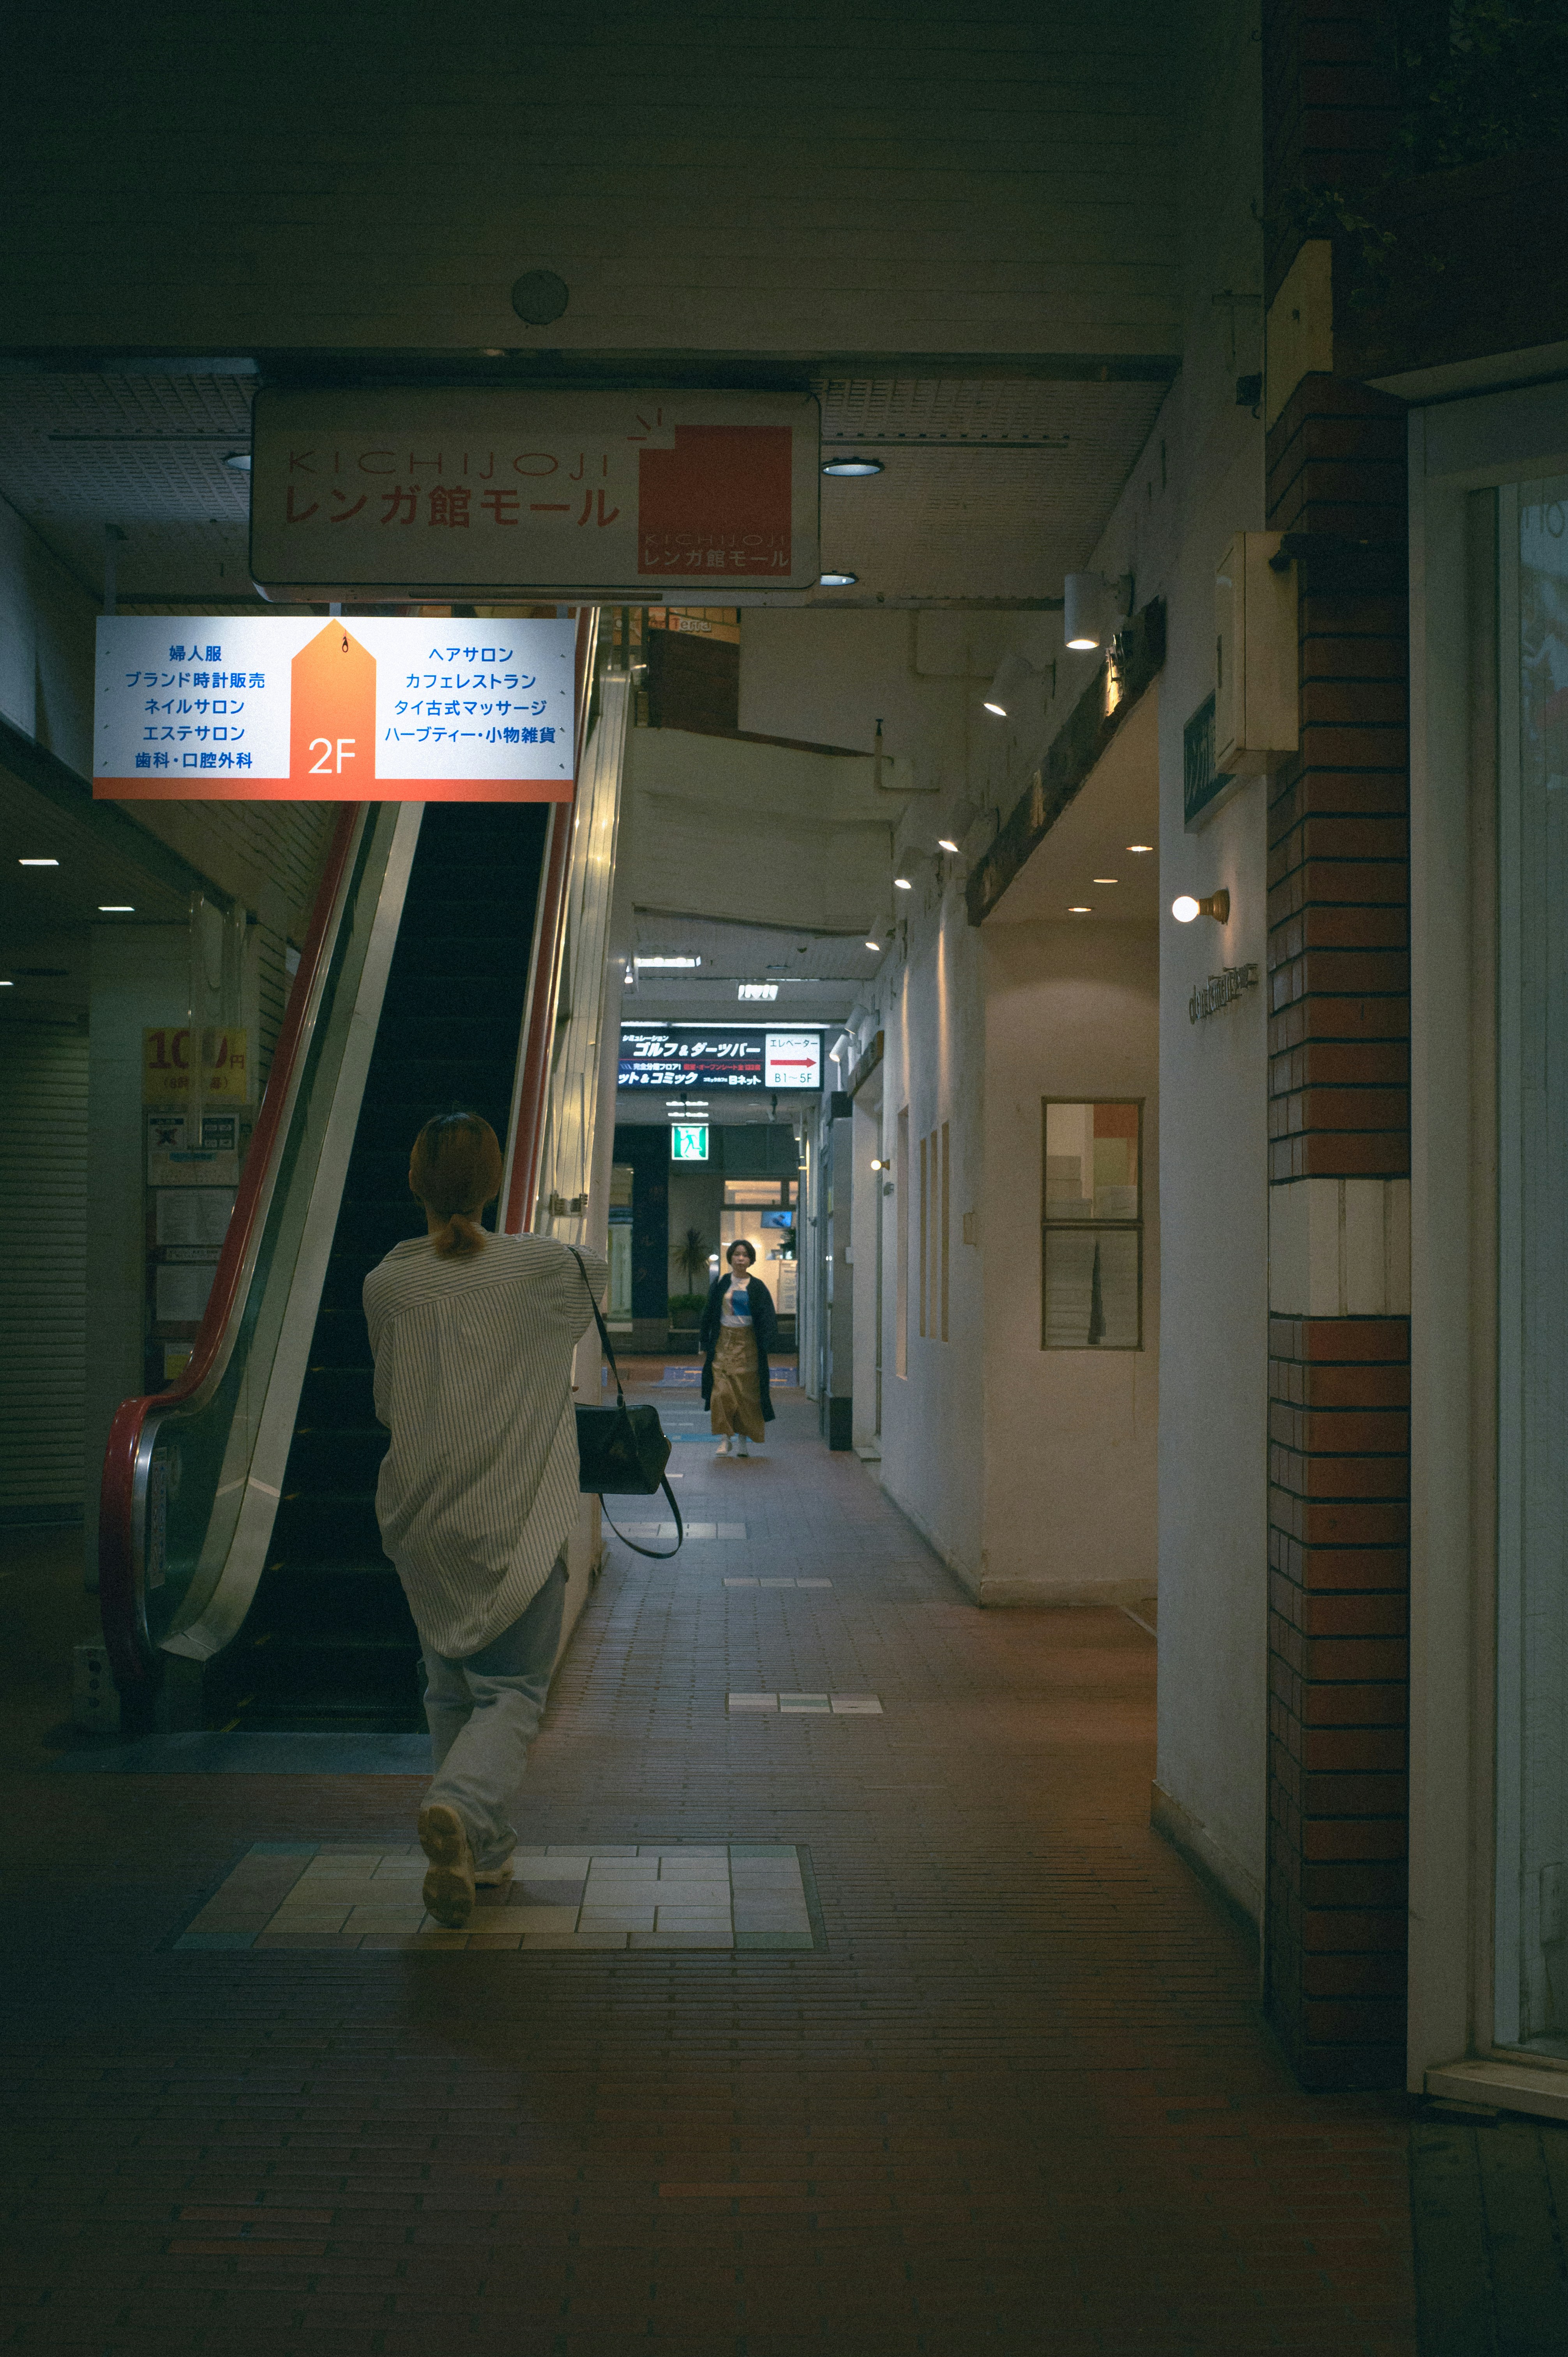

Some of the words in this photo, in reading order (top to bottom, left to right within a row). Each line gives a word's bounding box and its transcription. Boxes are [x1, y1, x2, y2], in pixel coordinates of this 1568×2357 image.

[290, 451, 608, 480] KICHIJOJI
[285, 485, 620, 528] レンガ館モール
[645, 534, 786, 546] KICHIJOJI
[645, 550, 789, 567] レンガ館モール
[169, 644, 222, 662] 婦人服
[429, 647, 513, 663] ヘアサロン
[125, 671, 265, 689] ブランド時計販売
[406, 673, 536, 689] カフェレストラン
[145, 698, 244, 714] ネイルサロン
[395, 700, 546, 716] タイ古式マッサージ
[143, 725, 245, 741] エステサロン
[385, 726, 555, 744] ハーブティー・小物雑貨
[135, 751, 253, 769] 歯科・口腔外科
[309, 738, 356, 774] 2F
[633, 1042, 761, 1057] ゴルフ&ダーツバー
[770, 1039, 818, 1048] エレベーター
